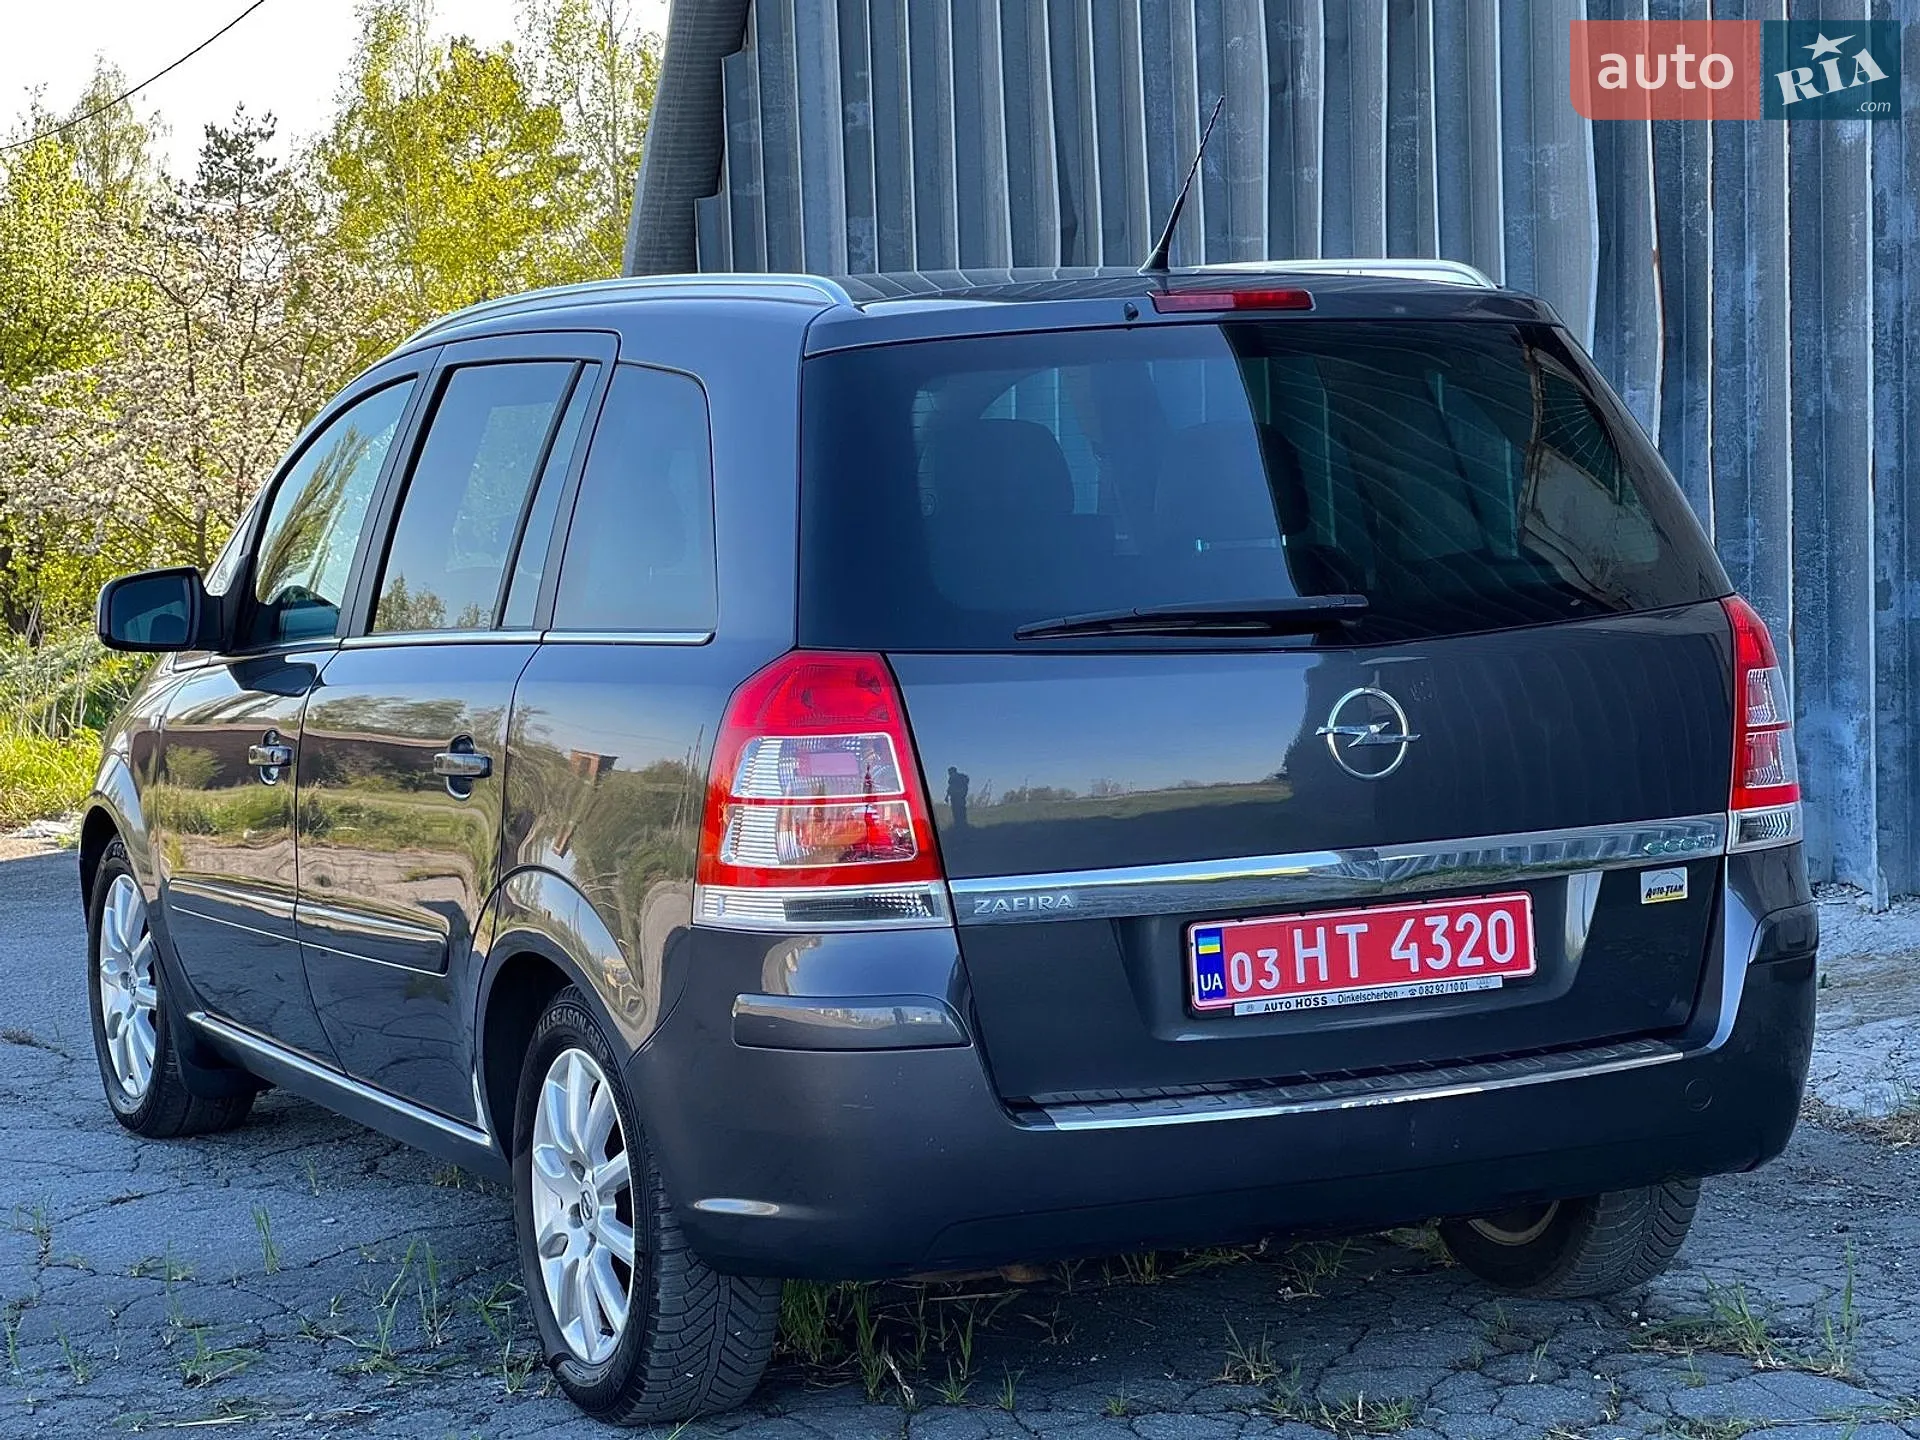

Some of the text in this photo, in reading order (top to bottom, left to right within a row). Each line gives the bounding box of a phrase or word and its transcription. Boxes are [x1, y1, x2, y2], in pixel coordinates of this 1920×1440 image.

[974, 894, 1074, 914] ZAFIRA
[1230, 909, 1516, 993] 03 HT 4320
[1201, 973, 1223, 992] UA
[1264, 1000, 1292, 1012] AUTO
[1295, 996, 1328, 1008] HOSS
[1337, 990, 1398, 1004] Dinkelscherben
